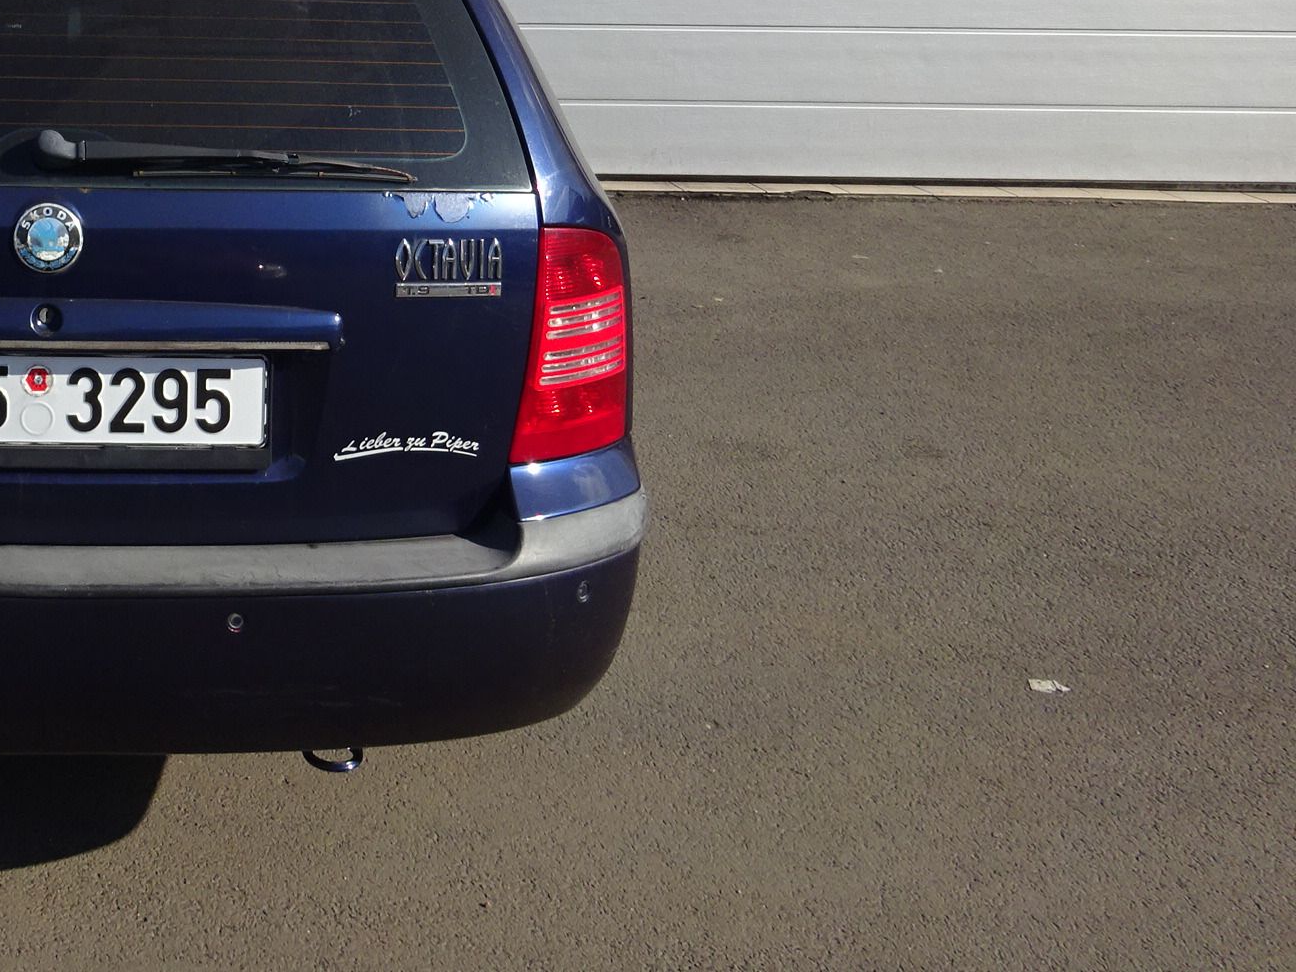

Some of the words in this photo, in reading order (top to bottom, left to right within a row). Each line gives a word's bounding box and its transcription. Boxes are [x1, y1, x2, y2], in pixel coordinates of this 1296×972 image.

[395, 237, 502, 281] OCTAVIA
[404, 286, 430, 296] 1.9
[465, 284, 497, 296] TDI
[67, 367, 232, 434] 3295
[341, 431, 402, 453] Lieber
[404, 435, 427, 452] zu
[431, 431, 480, 453] Piper
